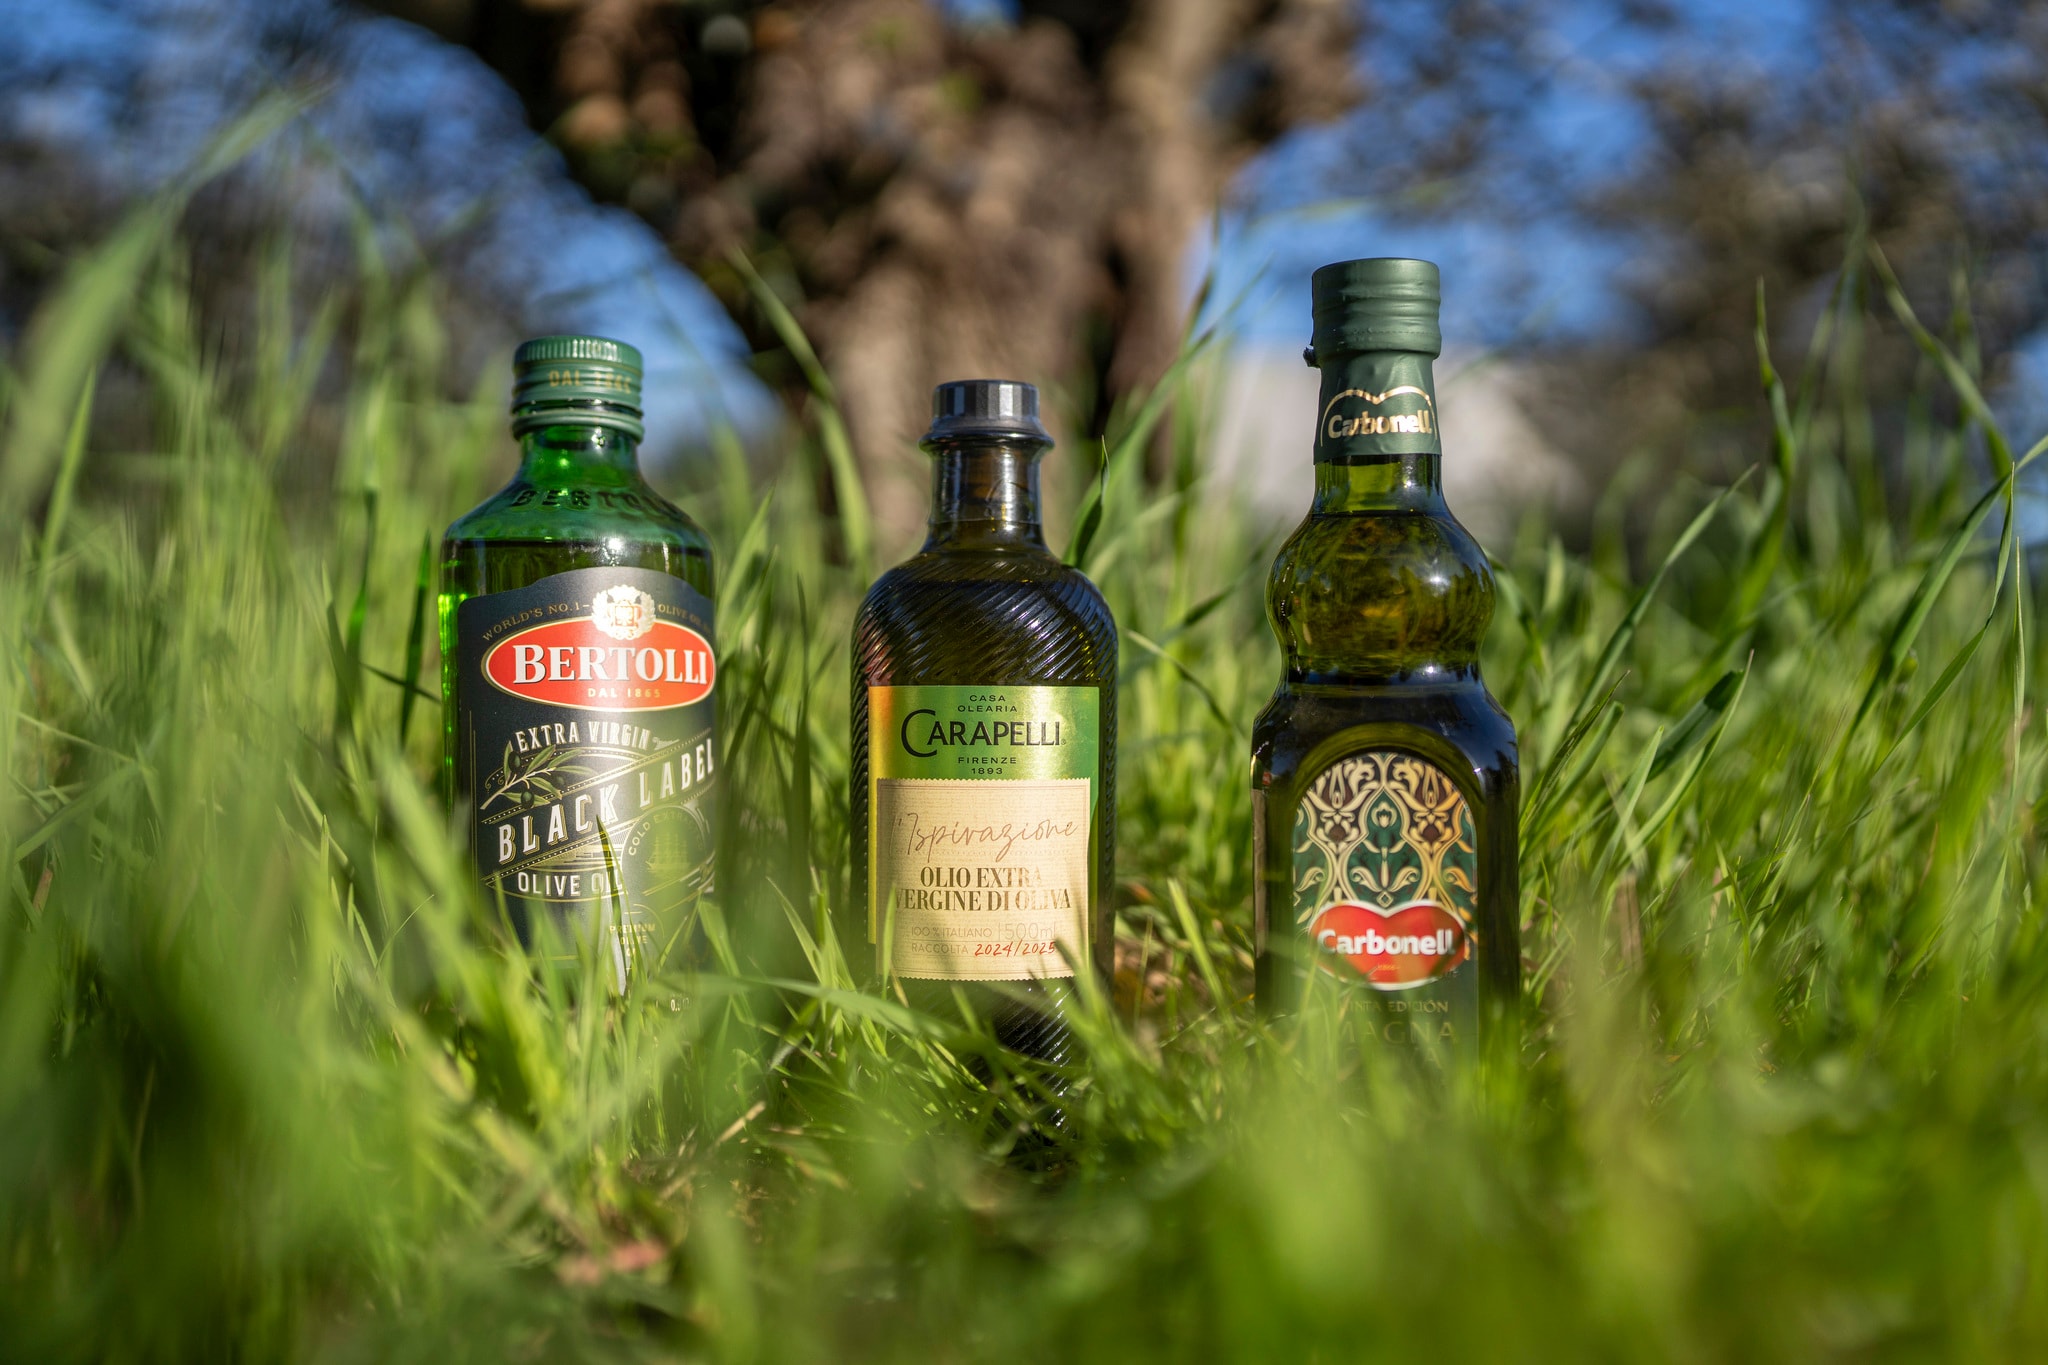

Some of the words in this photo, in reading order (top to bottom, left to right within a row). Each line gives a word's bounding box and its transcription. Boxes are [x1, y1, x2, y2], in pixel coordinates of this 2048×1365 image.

[549, 369, 584, 388] DAL
[1328, 410, 1429, 438] Carbonell
[482, 607, 543, 641] WORLD'S
[658, 603, 688, 619] OLIVE
[512, 644, 708, 685] BERTOLLI
[588, 688, 617, 698] DAL
[627, 688, 661, 698] 1865
[969, 694, 1006, 702] CASA
[957, 705, 1018, 713] OLEARIA
[515, 721, 580, 753] EXTRA
[588, 720, 651, 750] VIRGIN
[901, 709, 1060, 757] CARAPELLI
[957, 756, 1017, 764] FIRENZE
[971, 767, 1003, 775] 1893
[499, 783, 621, 865] BLACK
[639, 737, 715, 810] LABEL
[628, 821, 651, 856] COLD
[517, 871, 581, 897] OLIVE
[591, 872, 624, 895] OIL
[920, 866, 971, 888] OLIO
[976, 866, 1042, 888] EXTRA
[987, 890, 1010, 911] DI
[1015, 888, 1072, 911] OLIVA
[942, 926, 993, 938] ITALIANO
[1317, 928, 1454, 955] Carbonell
[911, 943, 969, 954] RACCOLTA
[974, 938, 1057, 957] 2024/2025
